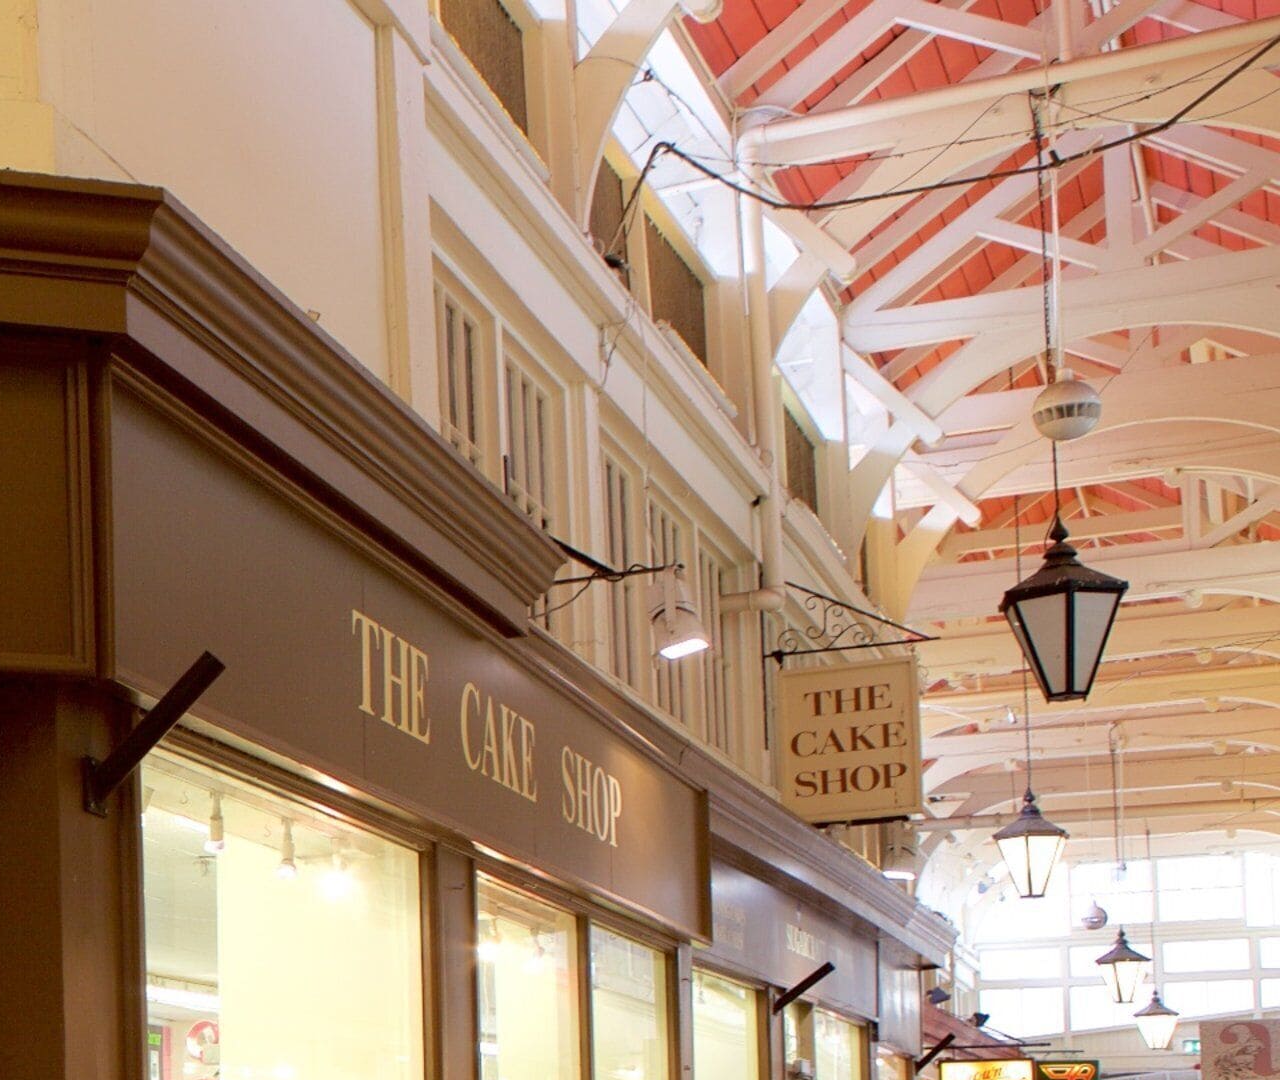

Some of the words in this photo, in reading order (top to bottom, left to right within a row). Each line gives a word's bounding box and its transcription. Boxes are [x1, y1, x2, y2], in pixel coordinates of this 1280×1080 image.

[803, 683, 893, 717] THE
[351, 608, 431, 745] THE
[460, 681, 537, 803] CAKE
[561, 744, 622, 848] SHOP
[790, 720, 908, 758] CAKE
[794, 761, 907, 798] SHOP
